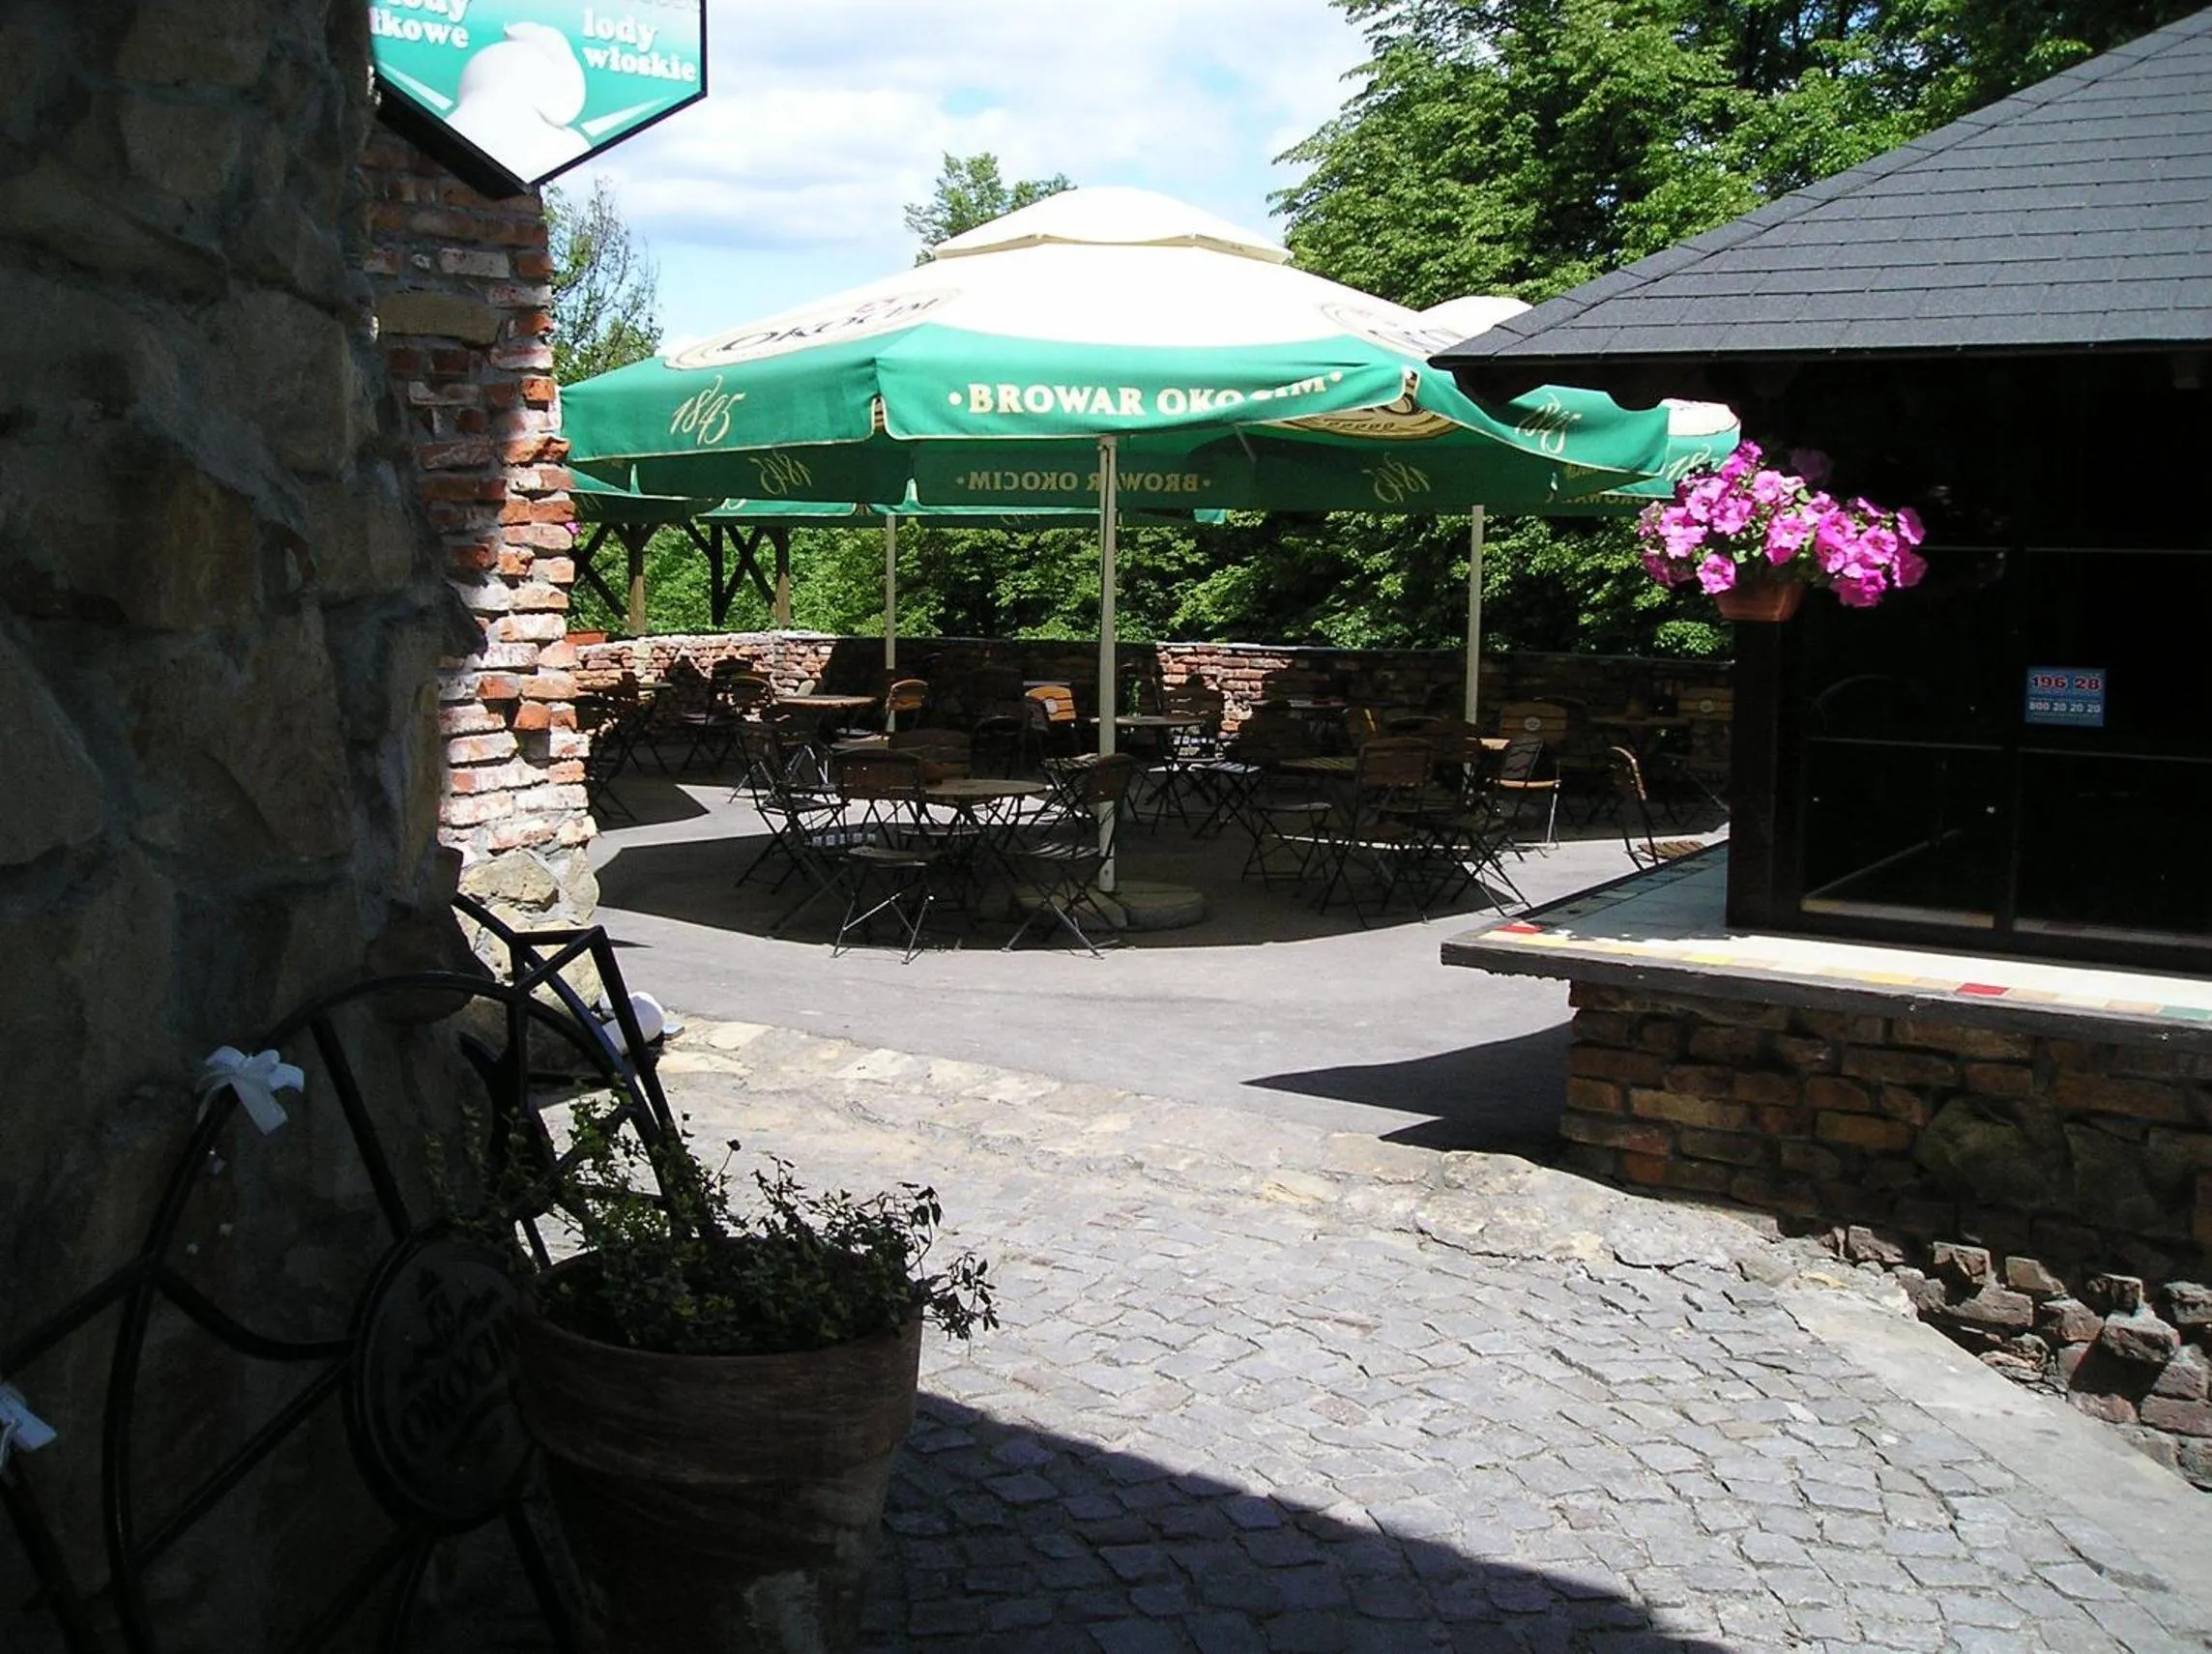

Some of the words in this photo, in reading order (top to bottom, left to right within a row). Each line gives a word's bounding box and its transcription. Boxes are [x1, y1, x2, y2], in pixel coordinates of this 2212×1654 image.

[582, 8, 657, 53] lody
[670, 375, 746, 445] 1845
[968, 383, 1145, 415] BROWAR
[2031, 675, 2067, 688] 196
[2074, 677, 2101, 690] 28
